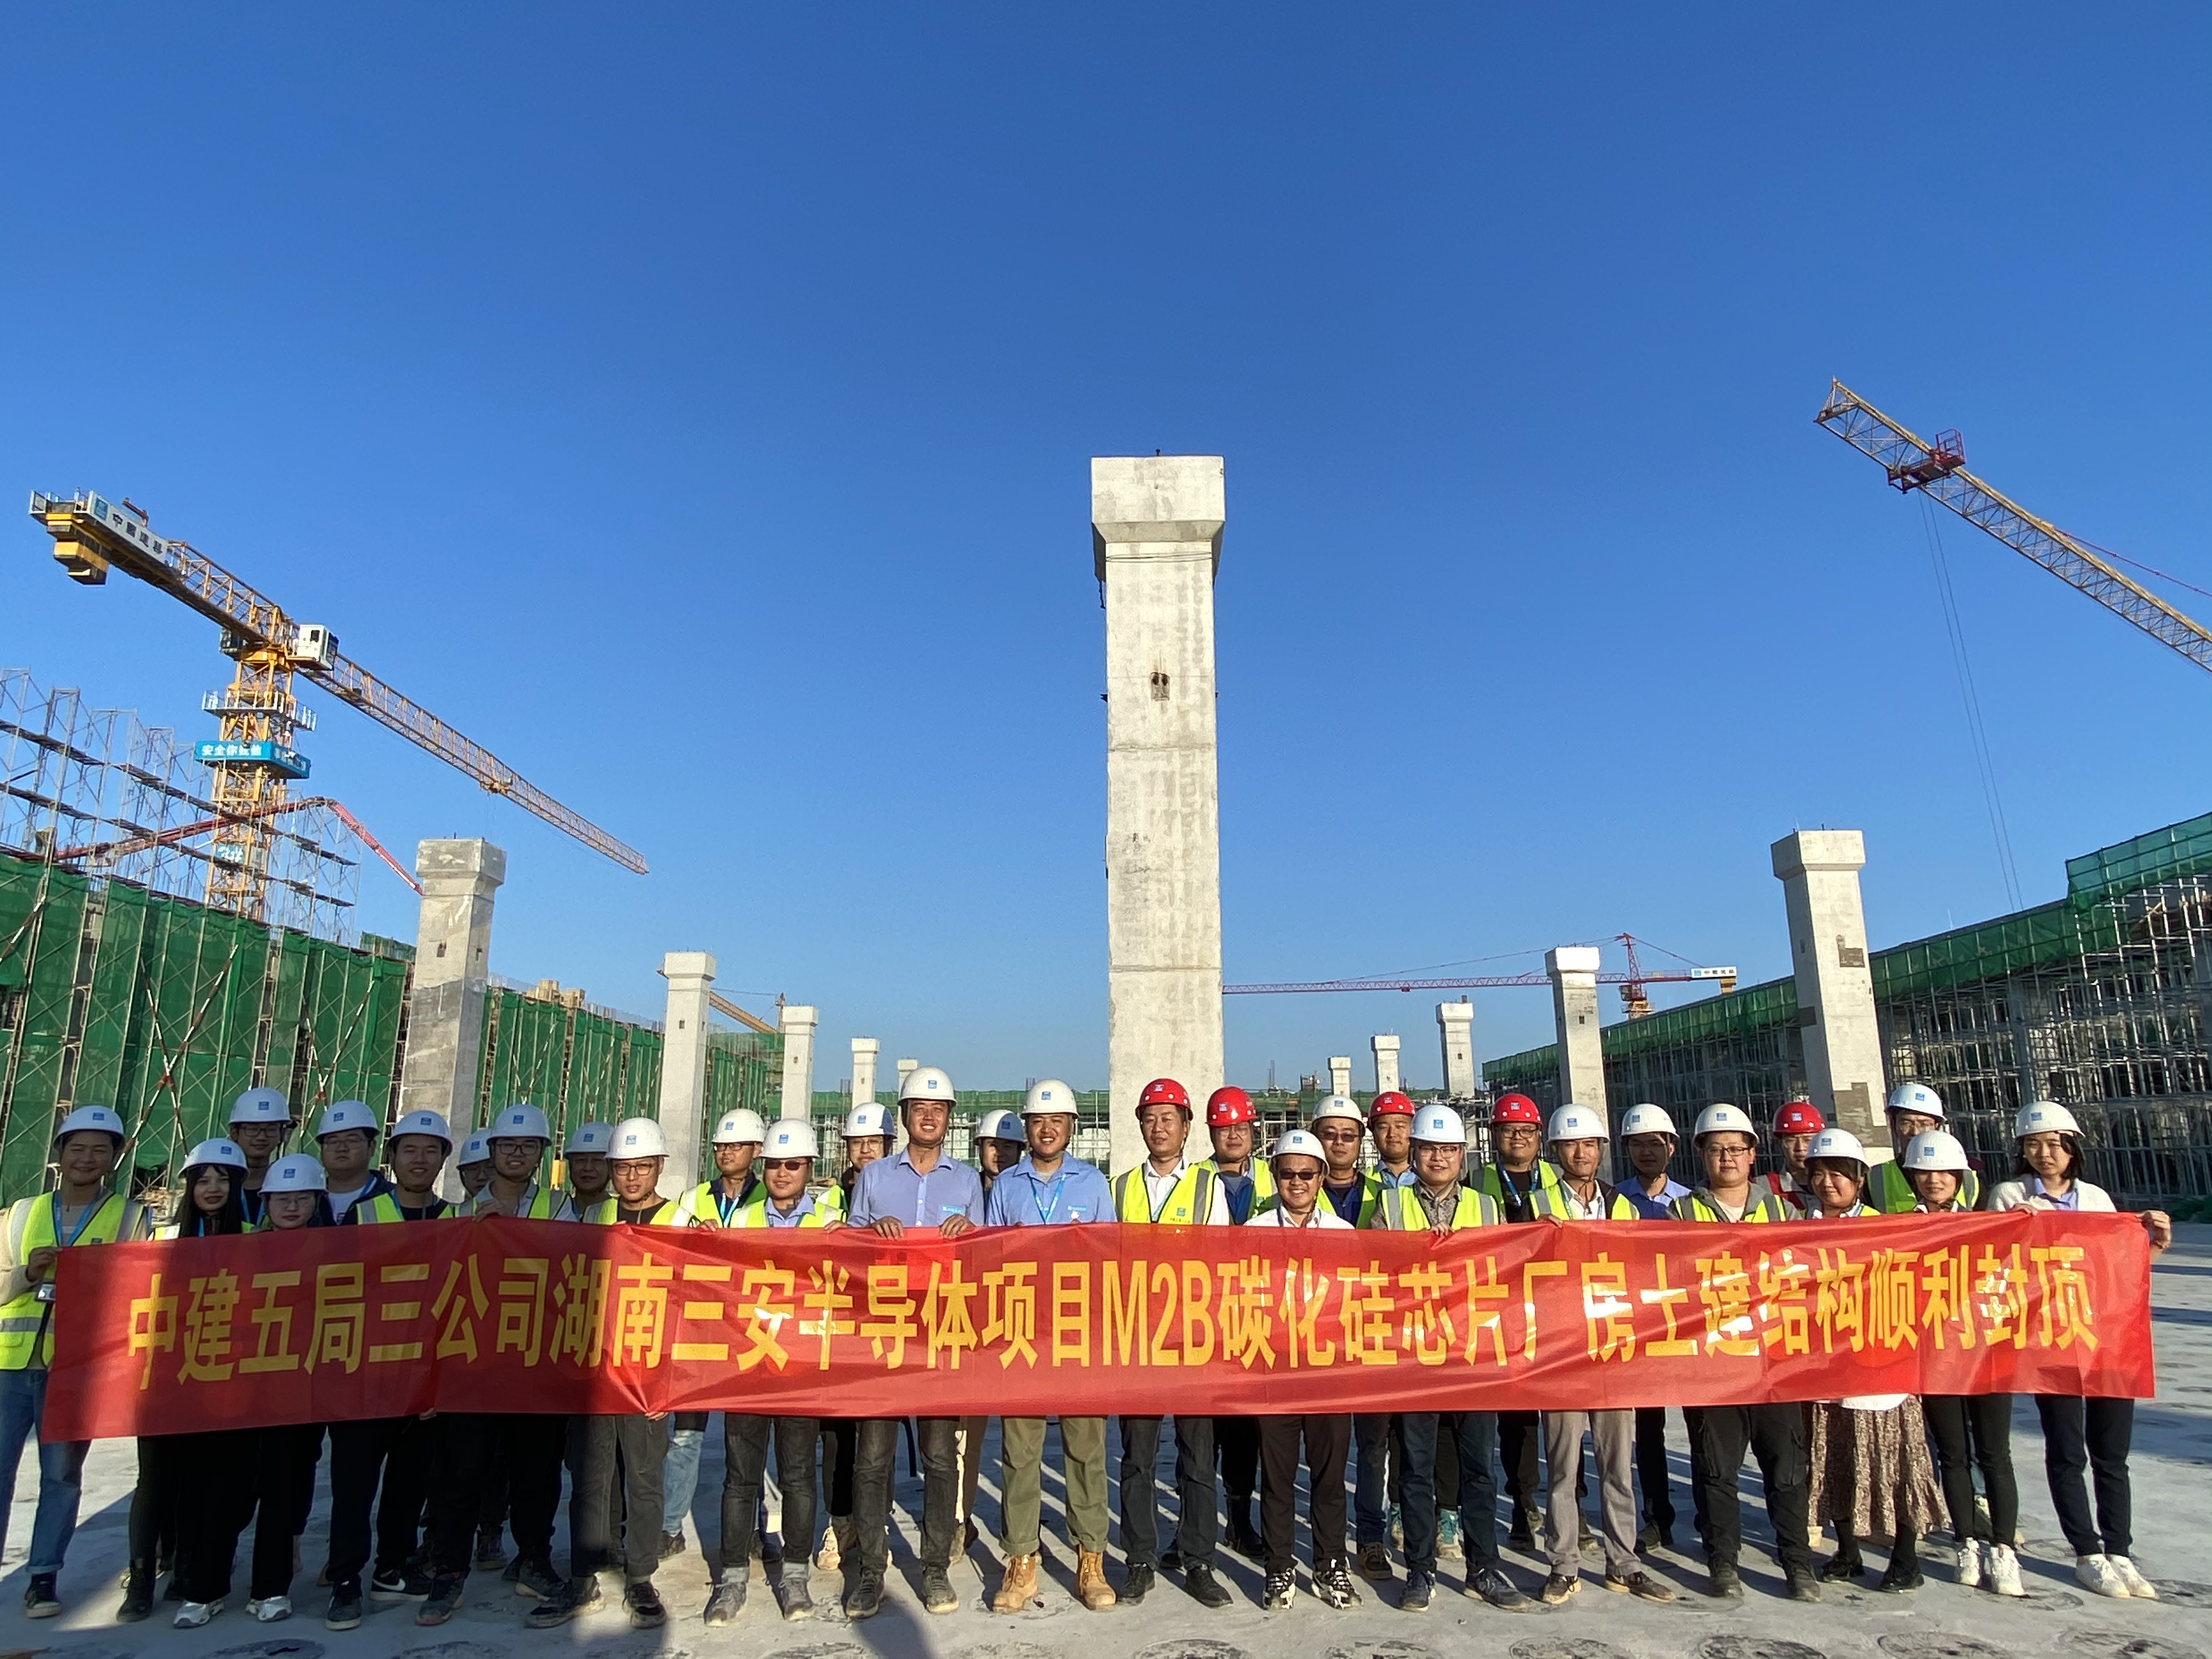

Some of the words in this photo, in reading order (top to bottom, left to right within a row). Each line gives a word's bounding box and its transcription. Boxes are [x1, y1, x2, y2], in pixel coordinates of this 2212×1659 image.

[129, 1243, 2099, 1390] 中建五局三公司湖南三安半导体项目M2B碳化硅芯片厂房土建结构顺利封顶
